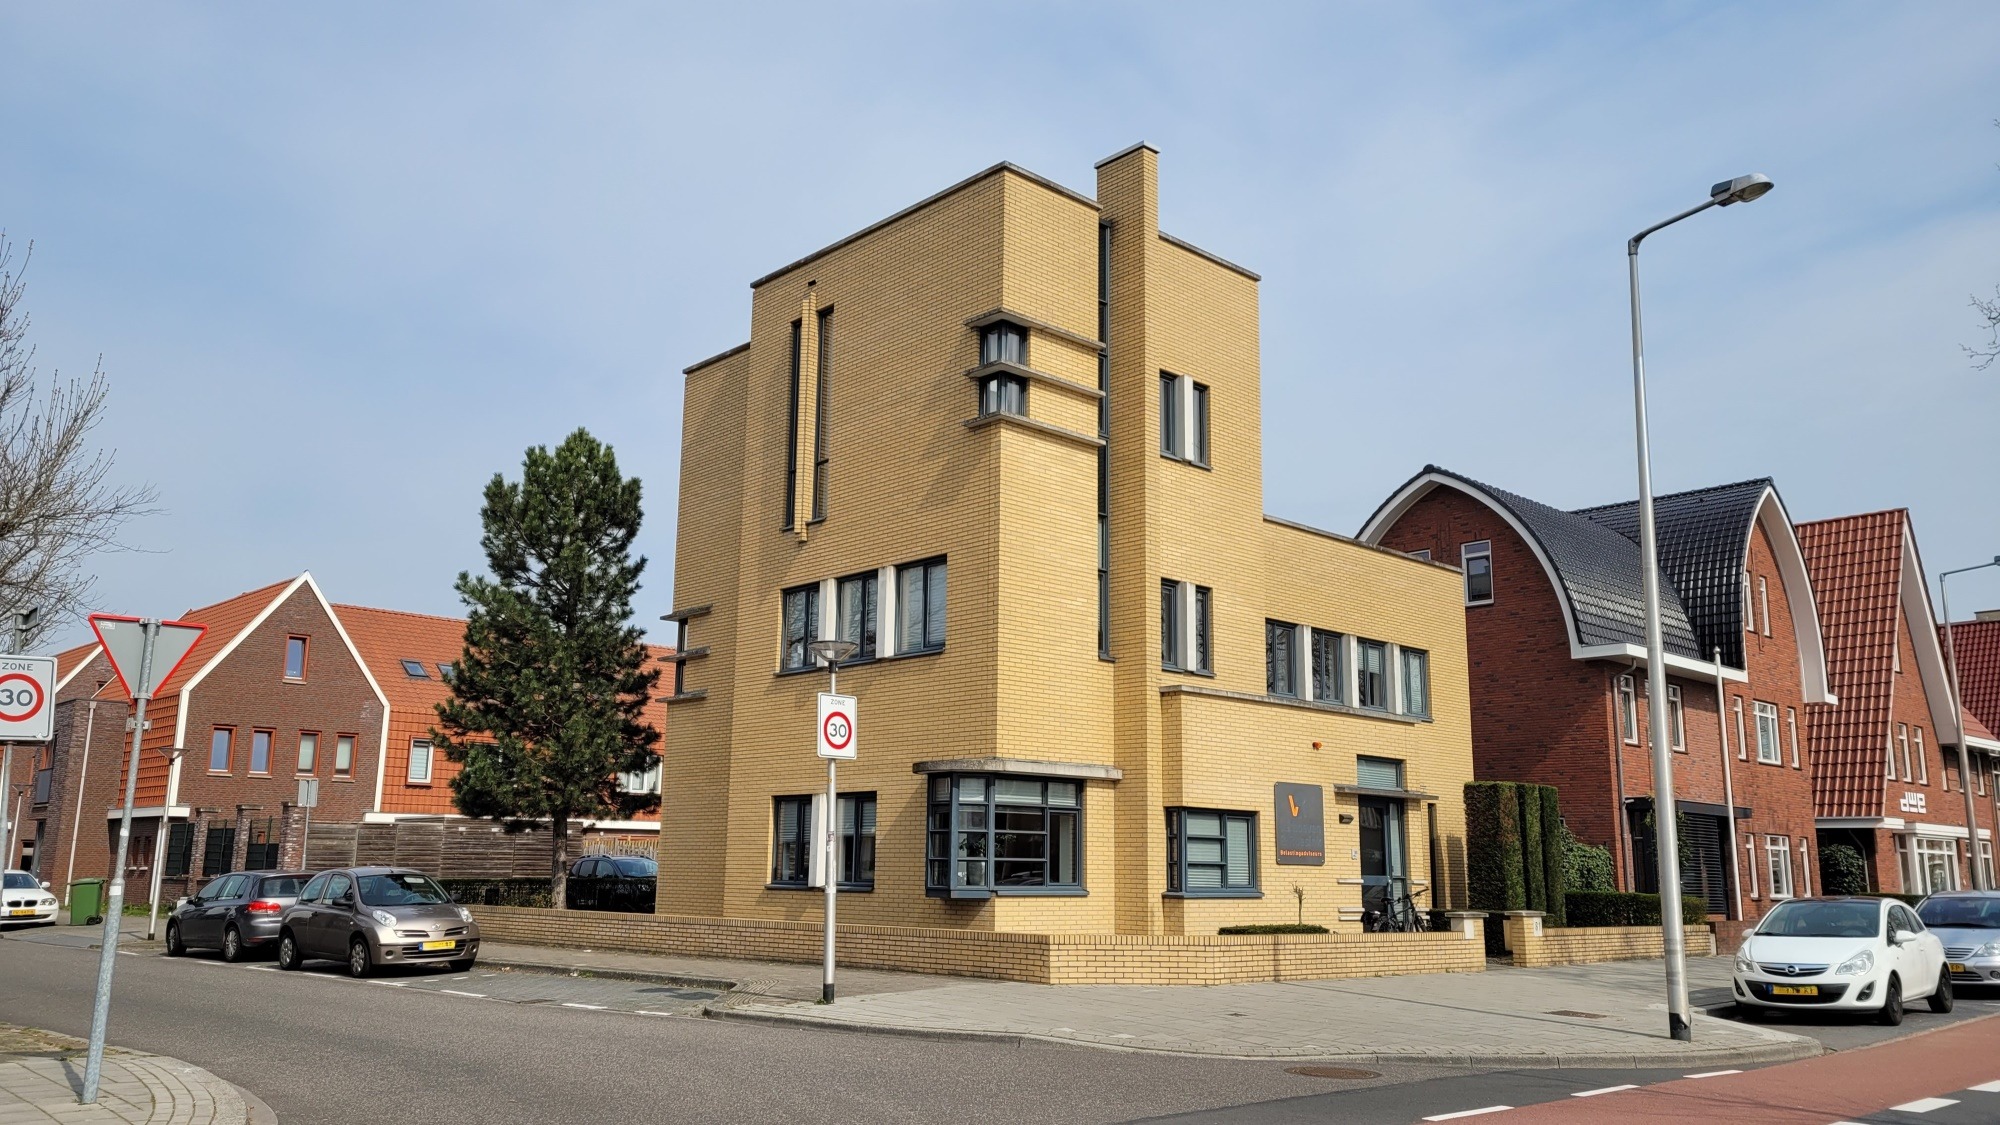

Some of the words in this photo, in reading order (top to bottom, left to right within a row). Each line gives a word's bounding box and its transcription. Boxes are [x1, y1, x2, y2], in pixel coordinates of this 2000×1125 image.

[2, 662, 34, 671] ZONE
[0, 688, 34, 707] 30
[829, 723, 847, 738] 30
